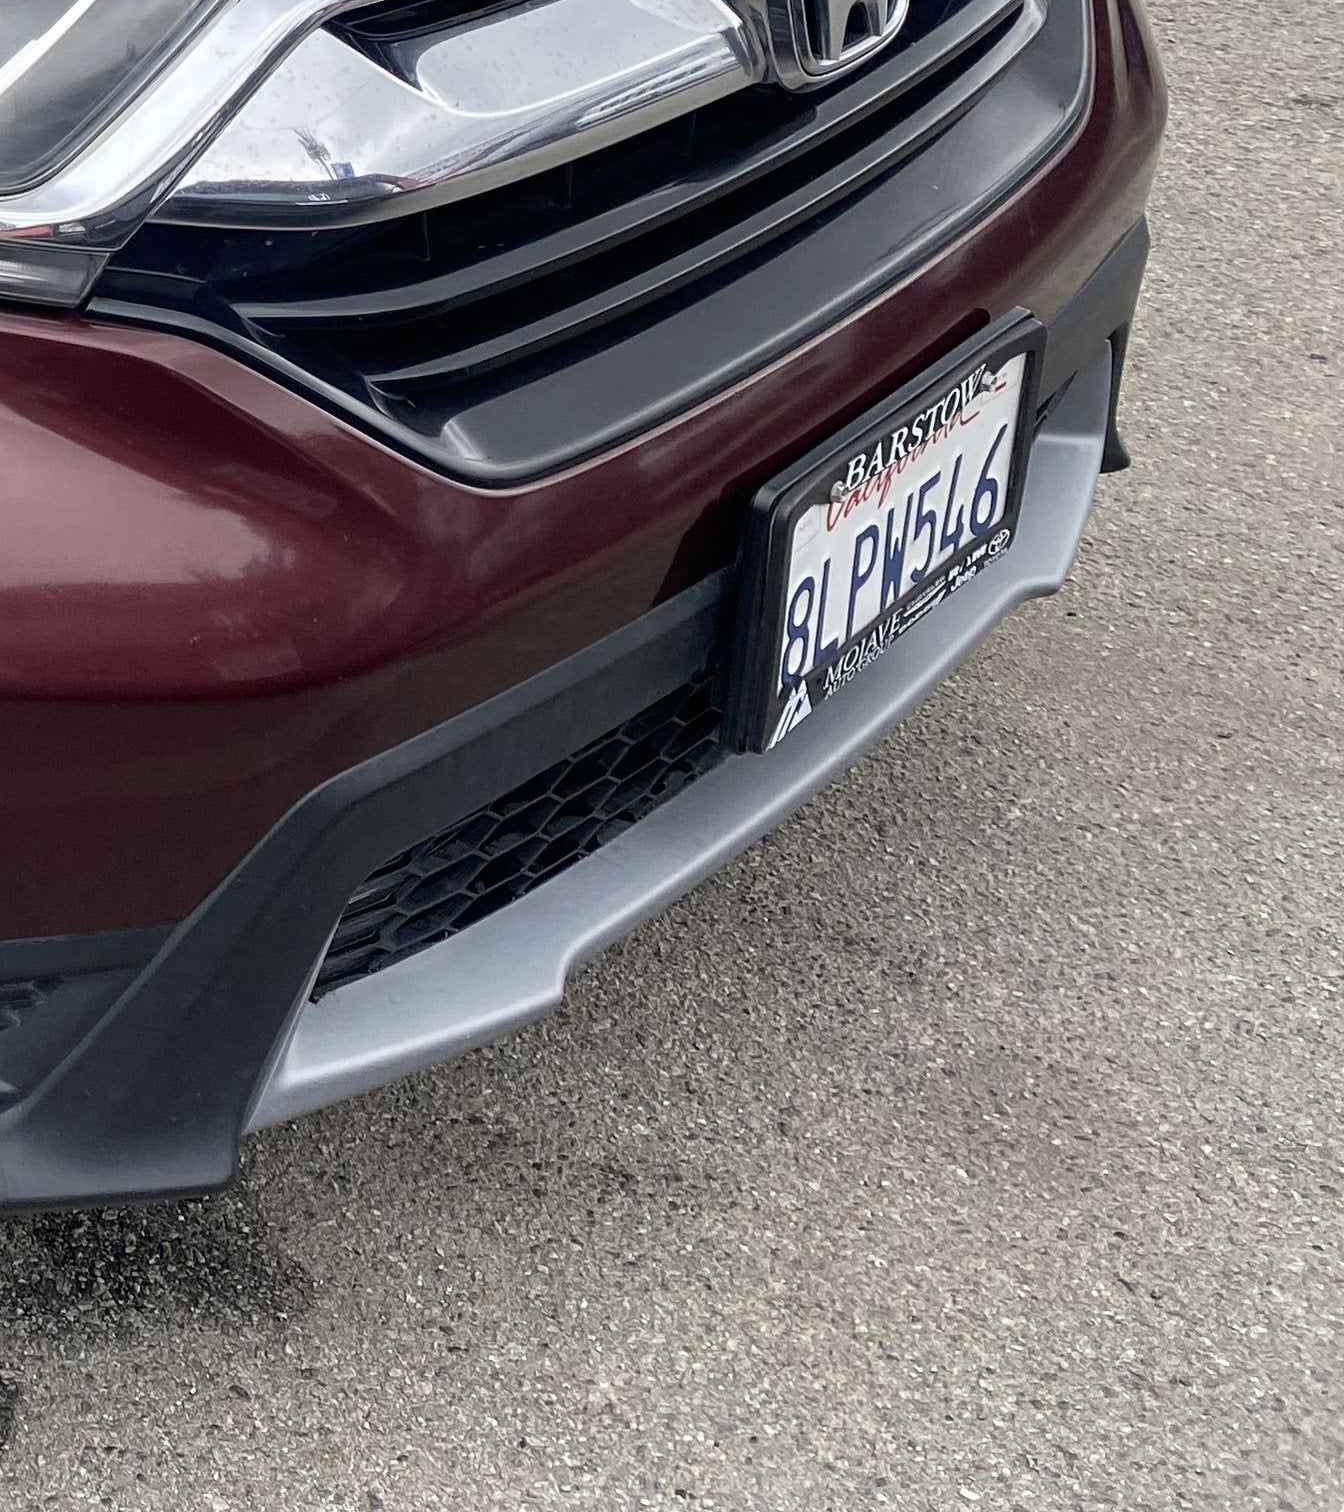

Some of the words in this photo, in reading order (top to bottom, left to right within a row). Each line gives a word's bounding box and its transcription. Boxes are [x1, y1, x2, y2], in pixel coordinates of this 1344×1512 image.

[845, 363, 987, 491] BARSTOW
[781, 423, 1009, 688] 8LPW546
[823, 607, 904, 690] MOJAVE
[823, 666, 856, 700] AUTO
